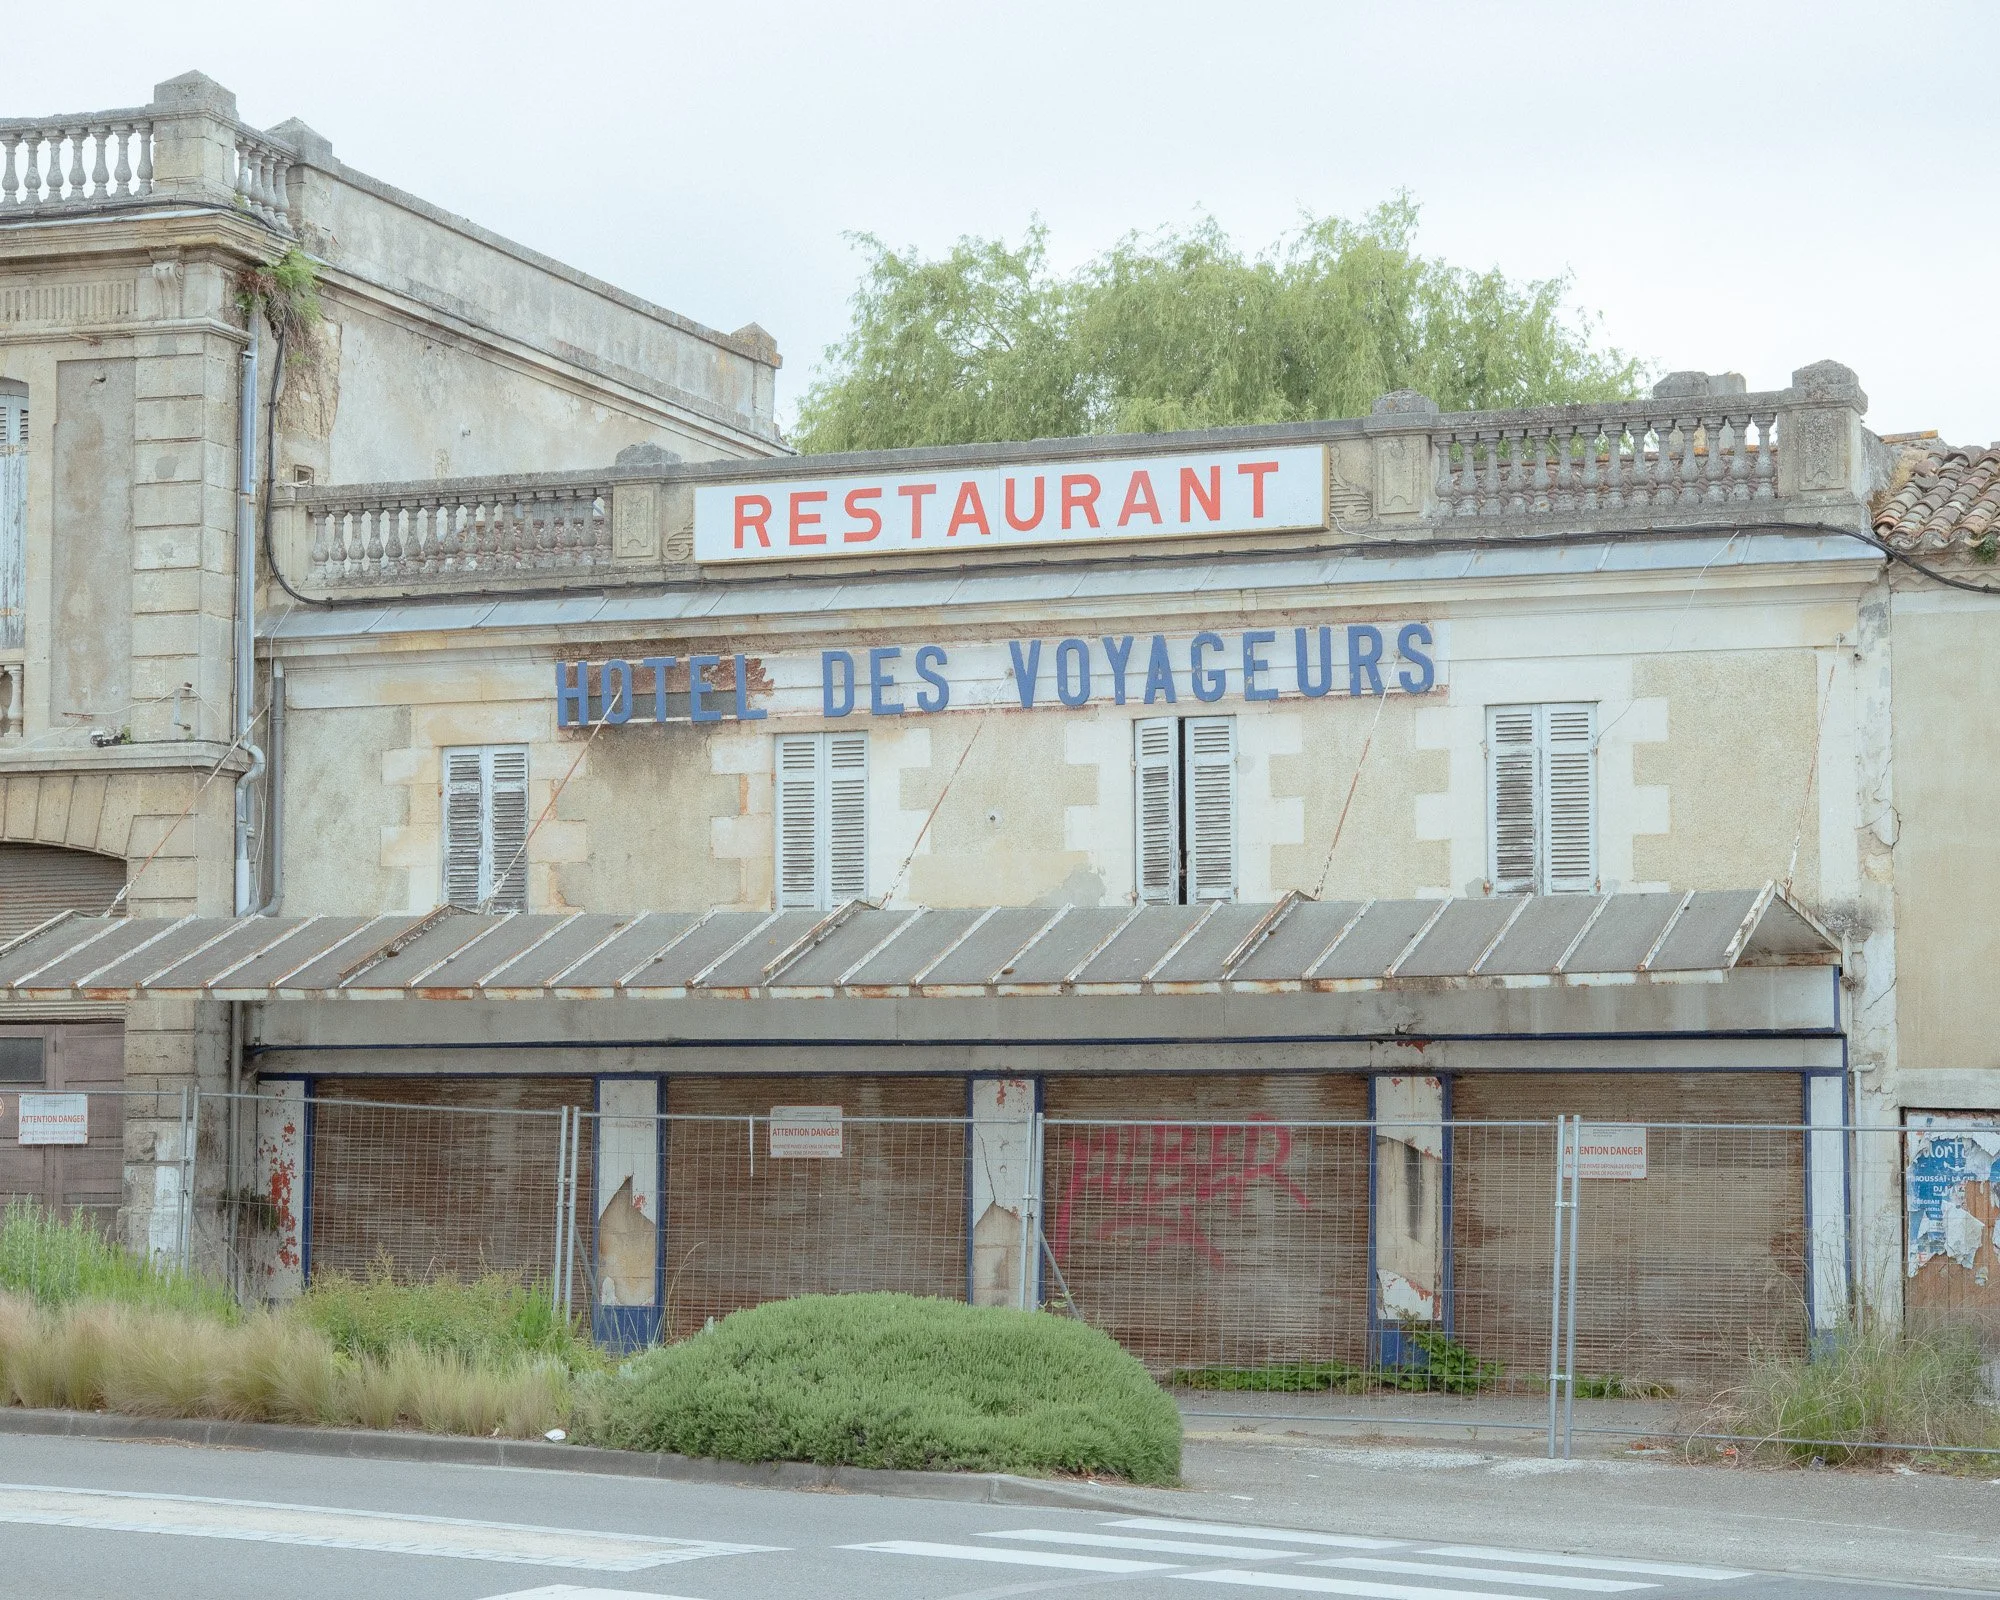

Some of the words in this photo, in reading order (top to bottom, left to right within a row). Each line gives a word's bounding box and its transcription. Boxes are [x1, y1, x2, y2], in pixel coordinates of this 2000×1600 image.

[733, 461, 1279, 549] RESTAURANT
[556, 654, 768, 728] HOTEL
[822, 645, 950, 718] DES
[1008, 623, 1435, 709] VOYAGEURS
[21, 1115, 57, 1123] ATTENTION
[58, 1115, 85, 1123] DANGER
[772, 1128, 810, 1137] ATTENTION
[811, 1128, 840, 1137] DANGER
[1565, 1146, 1610, 1155] ATENTION
[1611, 1146, 1643, 1155] DANGER
